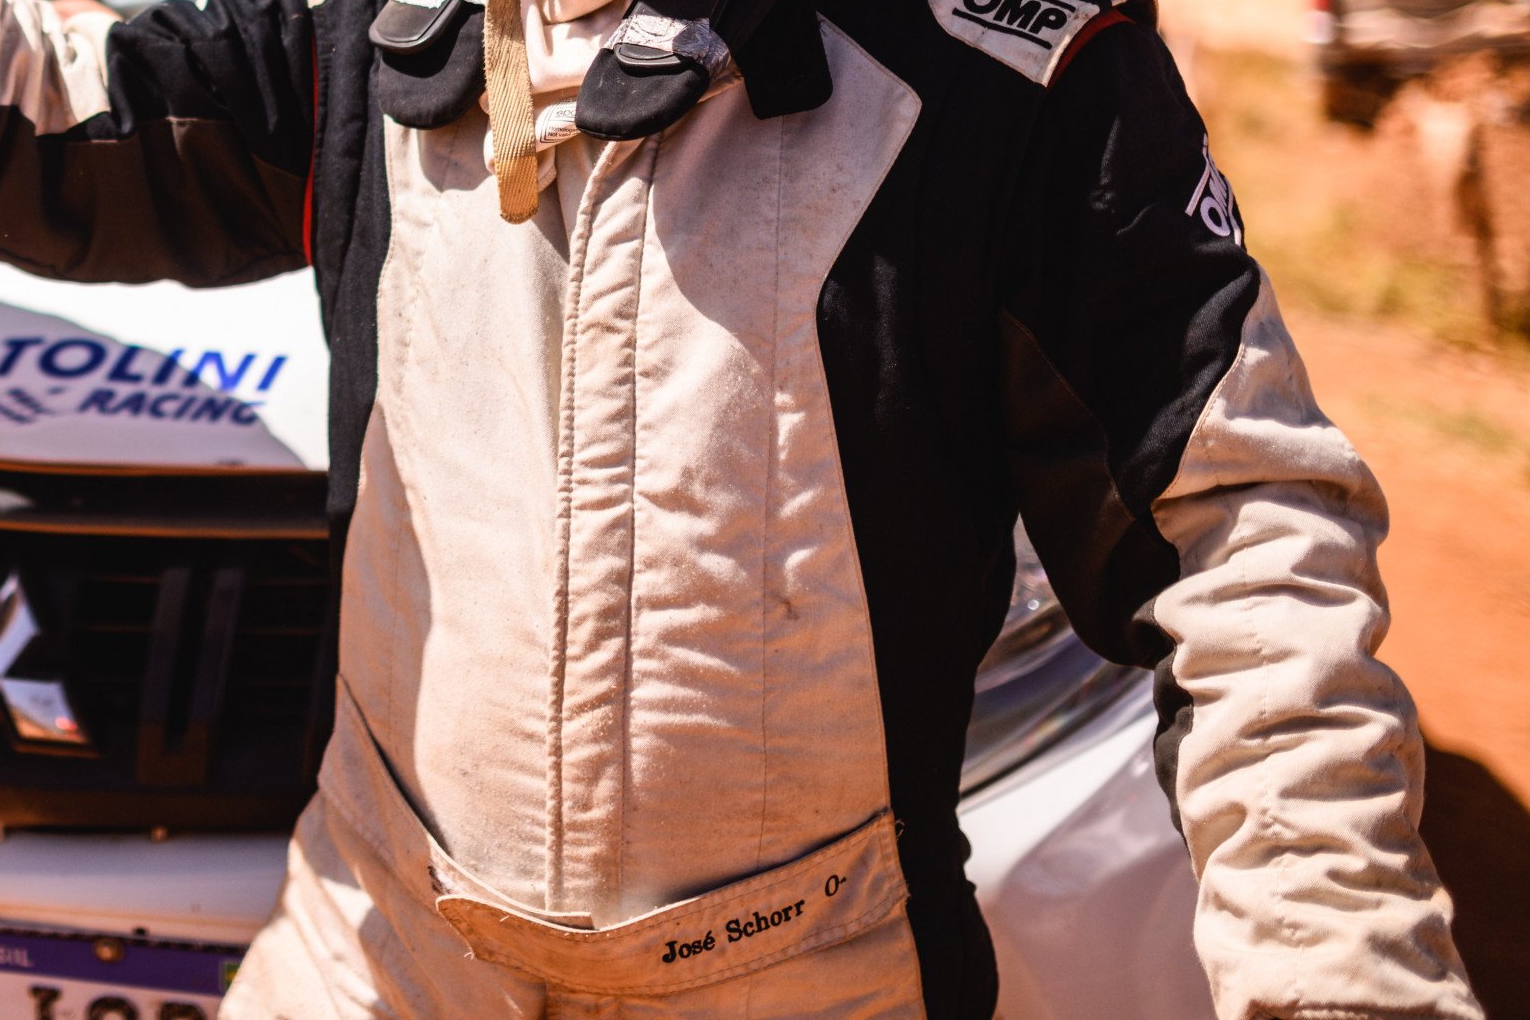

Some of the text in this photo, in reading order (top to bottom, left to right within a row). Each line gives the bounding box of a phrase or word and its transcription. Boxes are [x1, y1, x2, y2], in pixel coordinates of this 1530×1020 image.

[76, 387, 268, 426] RACING
[661, 929, 716, 964] José
[724, 899, 807, 944] Schorr
